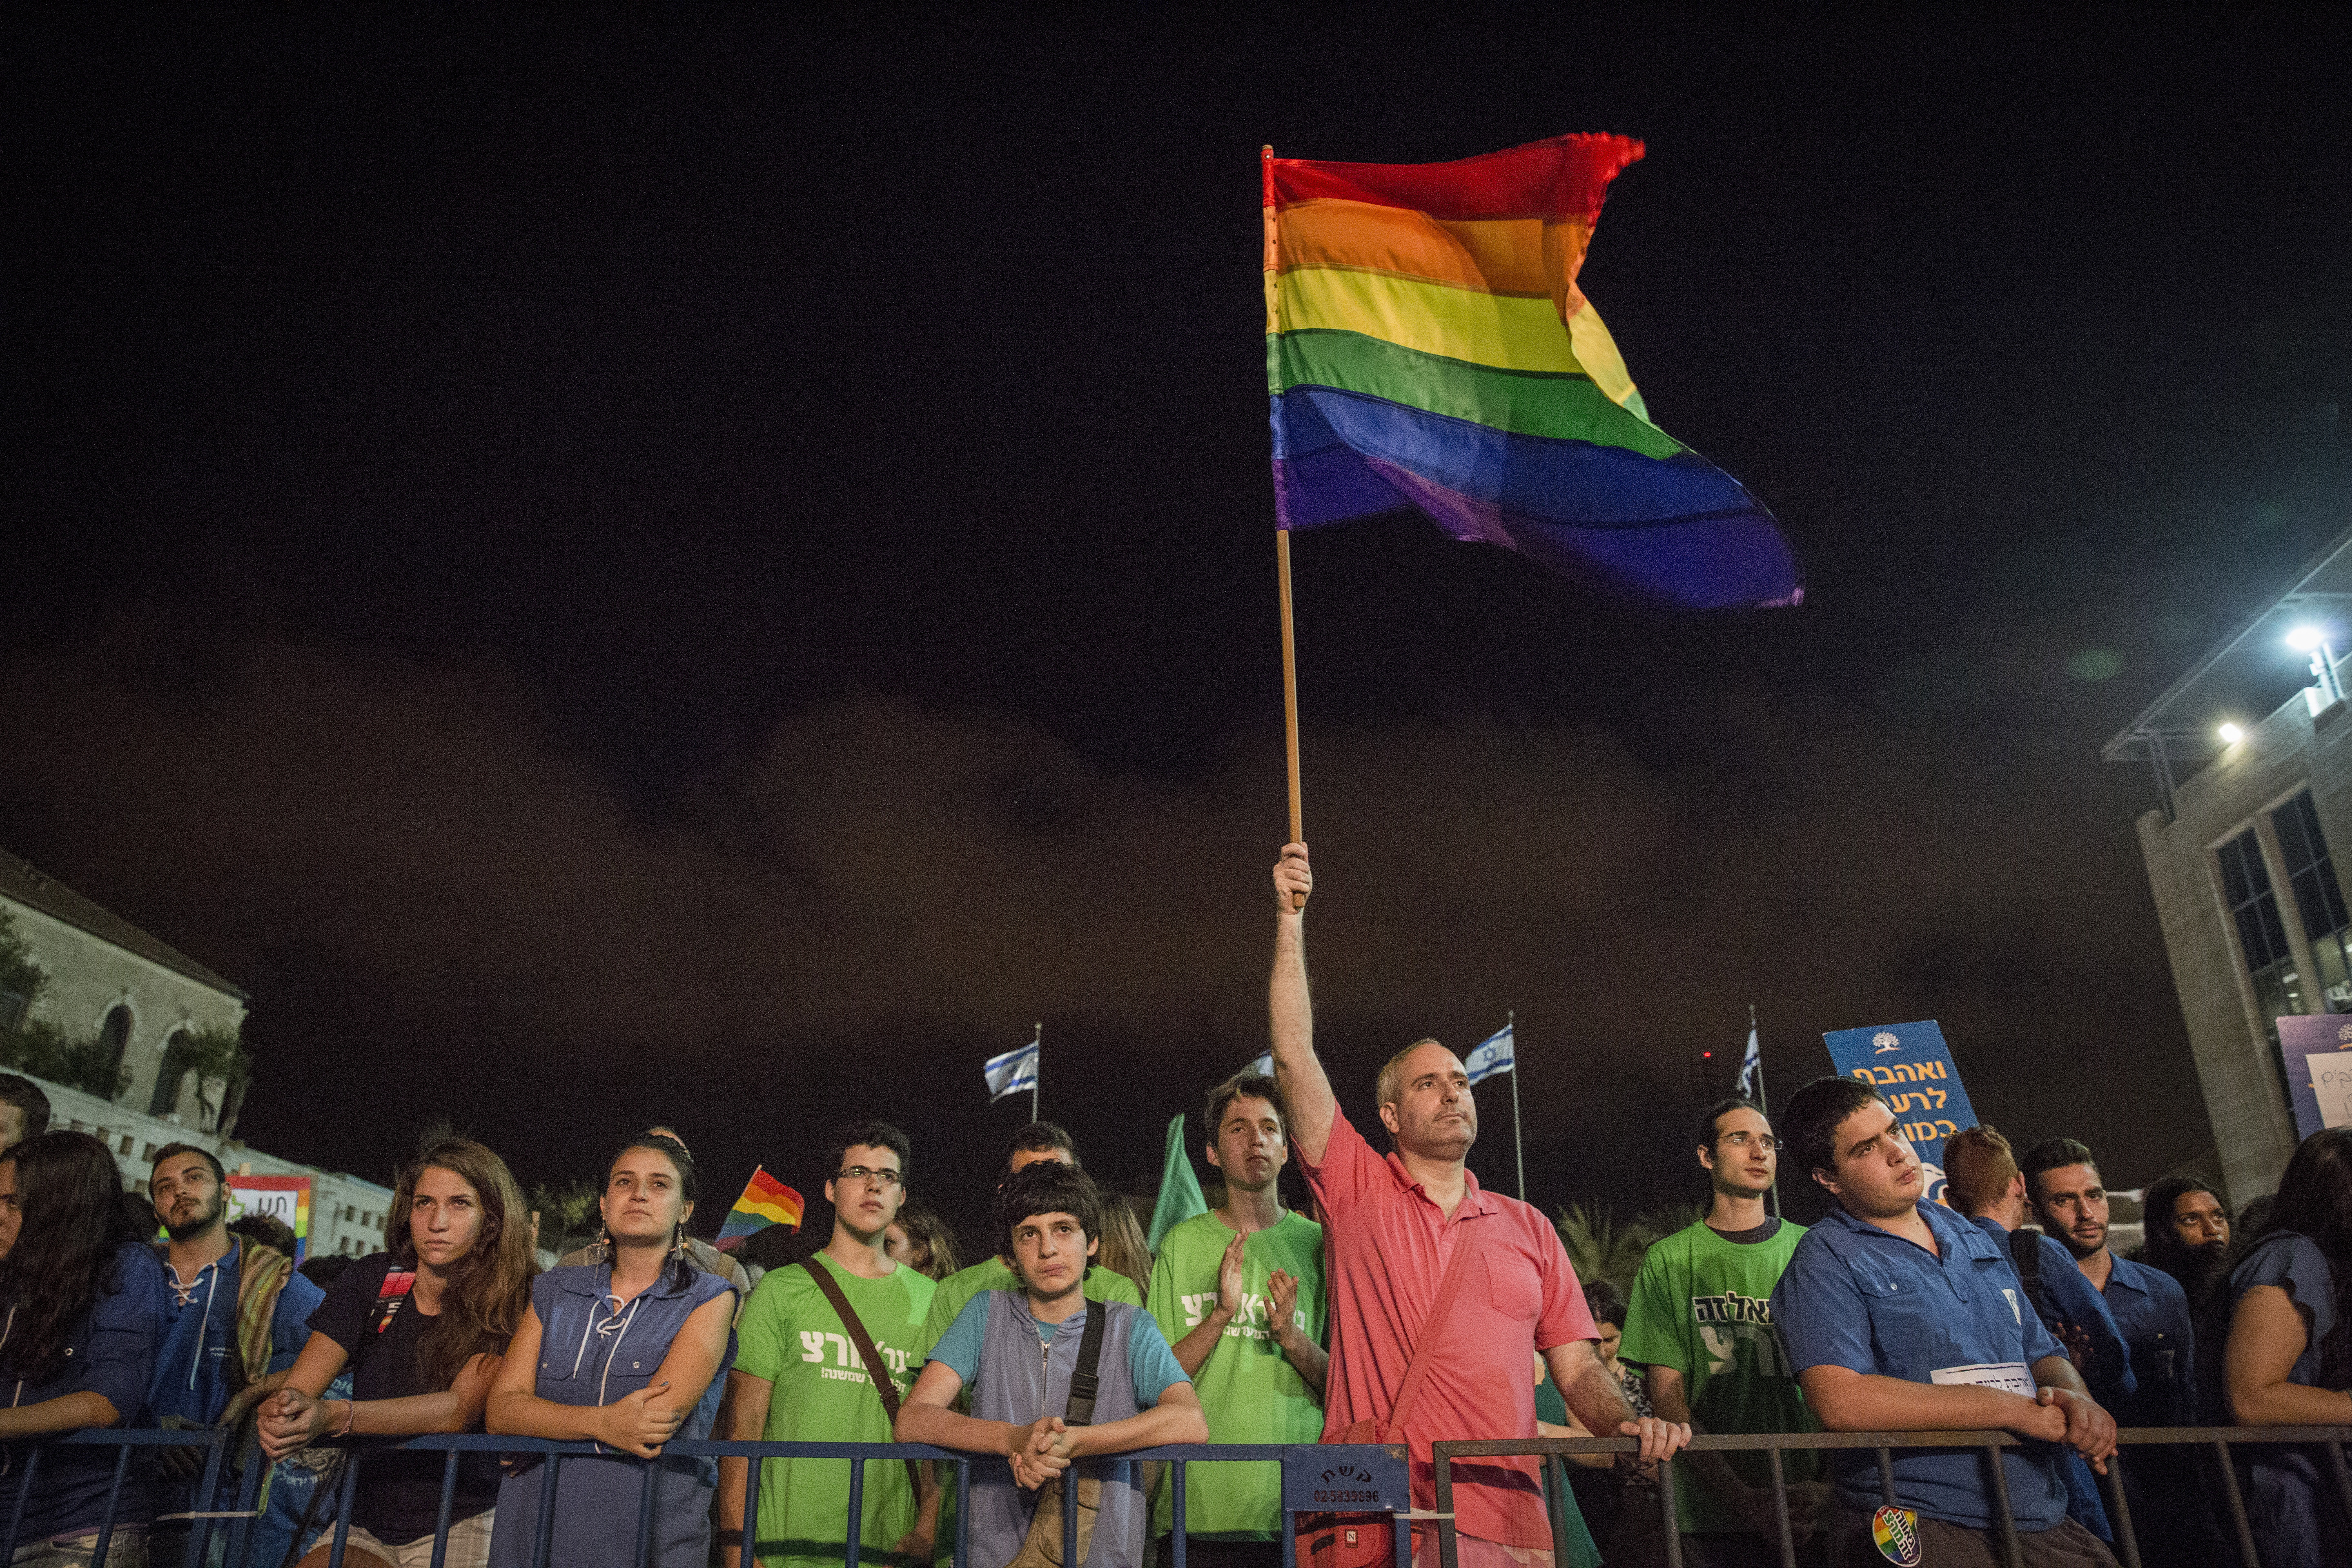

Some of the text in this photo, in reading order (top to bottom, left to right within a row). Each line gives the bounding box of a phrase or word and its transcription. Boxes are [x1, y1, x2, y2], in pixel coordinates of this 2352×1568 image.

[1852, 1060, 1947, 1085] ואהבת
[1890, 1087, 1947, 1113] לרע
[1901, 1120, 1957, 1142] כמו
[1692, 1295, 1728, 1323] זה
[821, 1367, 865, 1383] שמשנה!
[1884, 1511, 1904, 1543] מרצ
[1895, 1511, 1915, 1549] גאווה
[1899, 1541, 1912, 1559] זה
